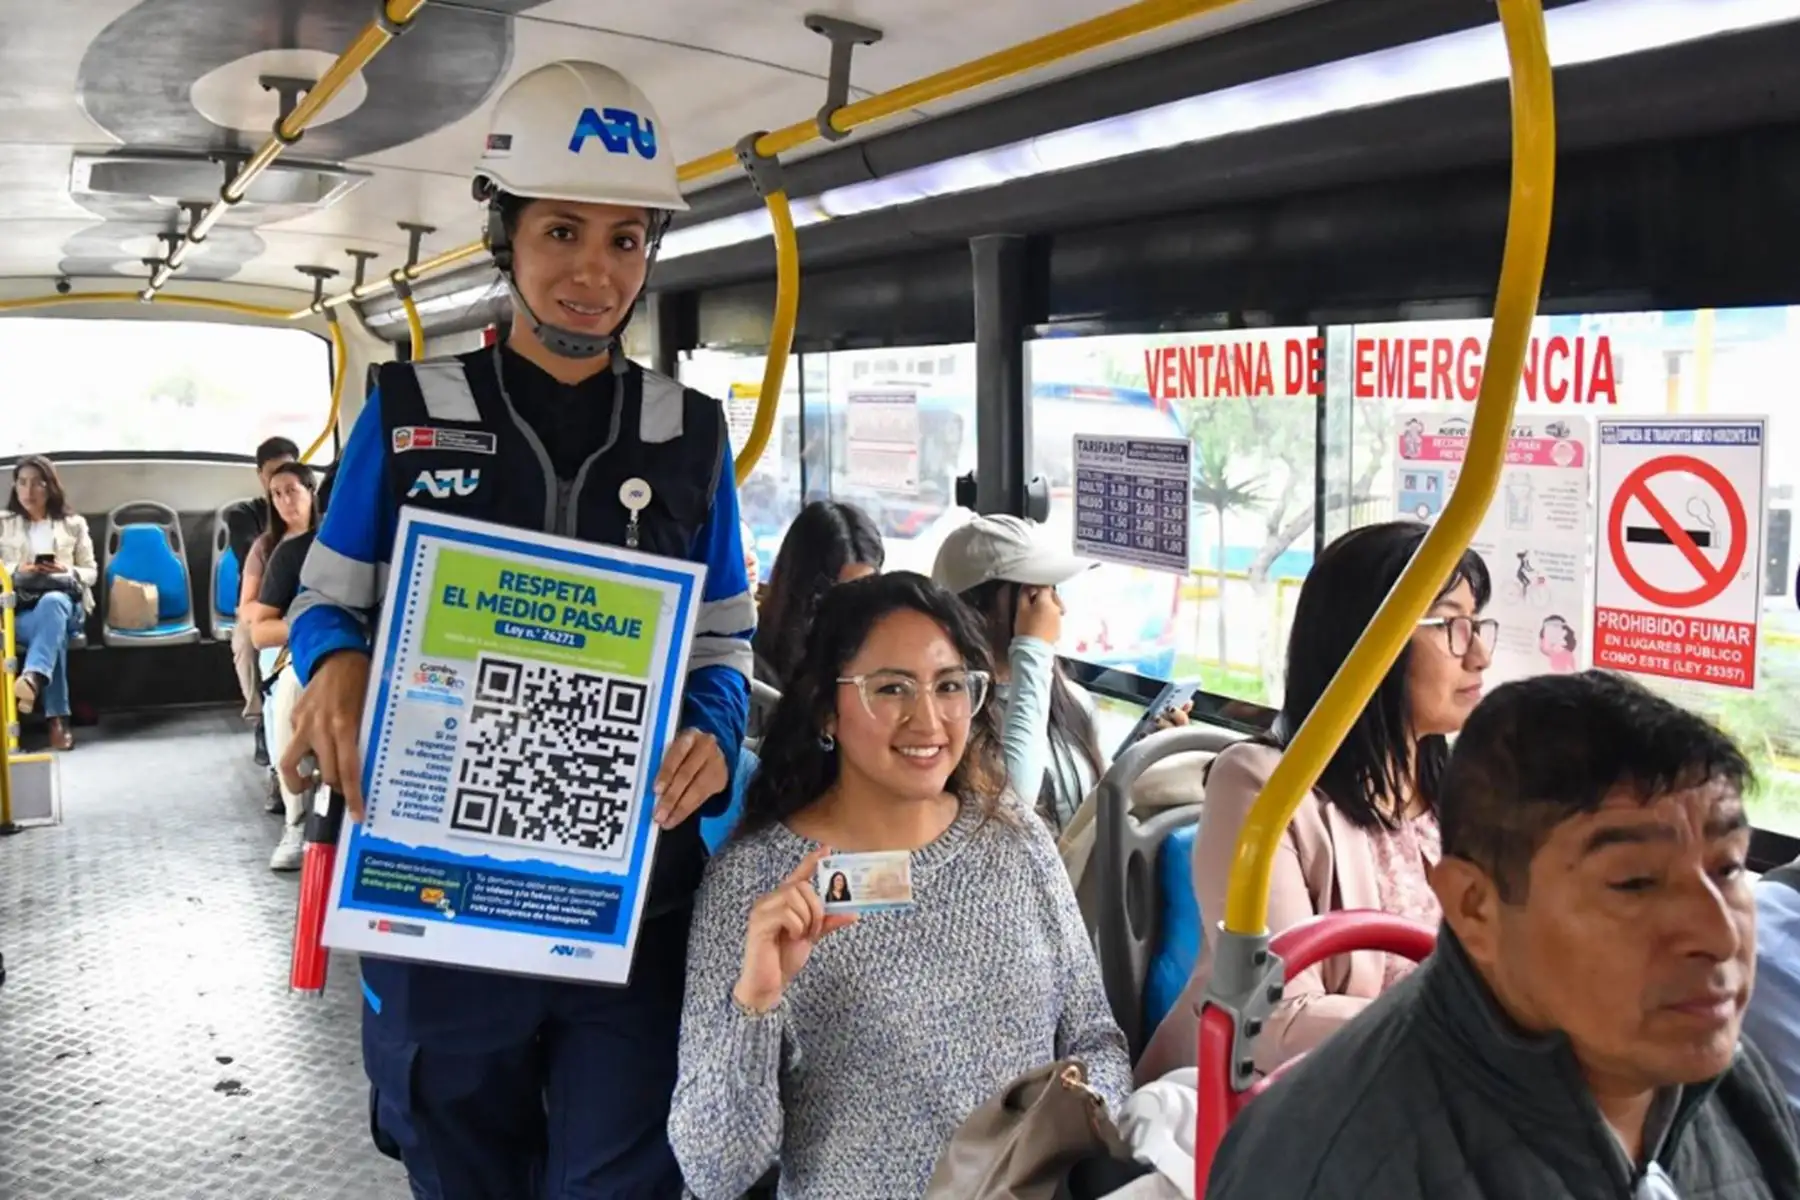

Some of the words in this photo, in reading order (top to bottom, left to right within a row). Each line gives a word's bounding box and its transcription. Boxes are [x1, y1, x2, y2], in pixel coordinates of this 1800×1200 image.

[568, 107, 657, 160] ATU
[1144, 340, 1274, 400] VENTANA
[1285, 337, 1325, 396] DE
[1355, 335, 1617, 404] EMERGNCIA
[1077, 439, 1126, 456] TARIFARIO
[406, 468, 480, 498] ATU
[499, 570, 597, 606] RESPETA
[442, 584, 469, 609] EL
[476, 591, 556, 623] MEDIO
[562, 606, 643, 639] PASAJE
[1597, 611, 1686, 638] PROHIBIDO
[1689, 620, 1751, 646] FUMAR
[504, 623, 524, 638] Ley
[542, 628, 576, 646] 26271
[1604, 633, 1621, 646] EN
[1623, 636, 1681, 654] LUGARES
[1600, 650, 1637, 665] COMO
[1639, 655, 1671, 670] ESTE
[1673, 659, 1702, 675] (LEY
[1705, 664, 1746, 683] 25357)
